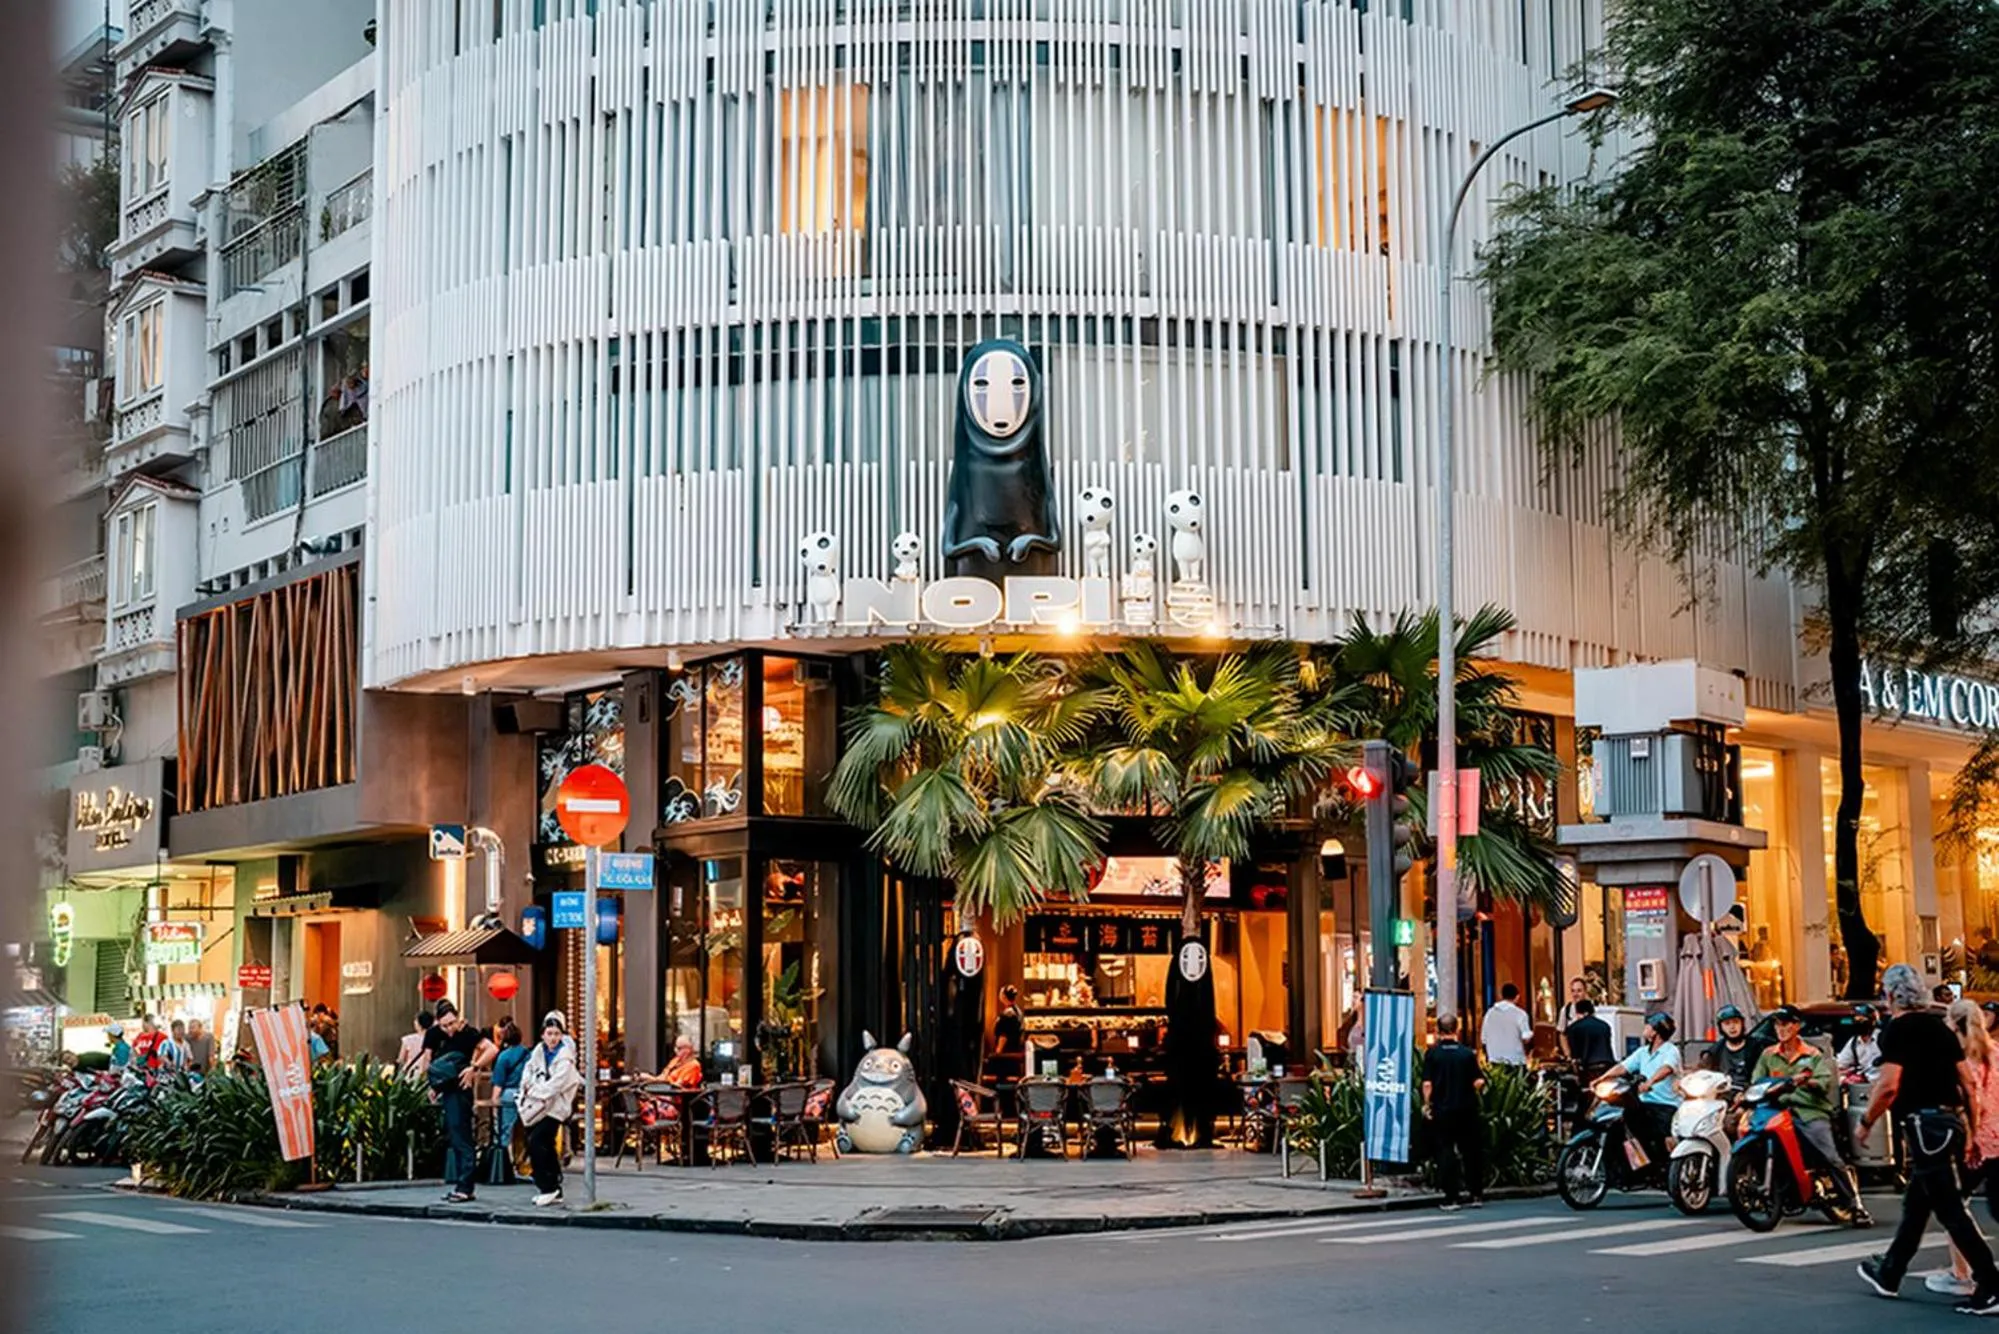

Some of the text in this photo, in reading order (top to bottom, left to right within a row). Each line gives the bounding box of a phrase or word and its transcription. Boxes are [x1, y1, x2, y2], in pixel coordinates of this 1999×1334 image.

[844, 577, 1111, 627] NORI
[1860, 658, 1999, 731] A & EM COR
[1366, 1081, 1406, 1093] NORI
